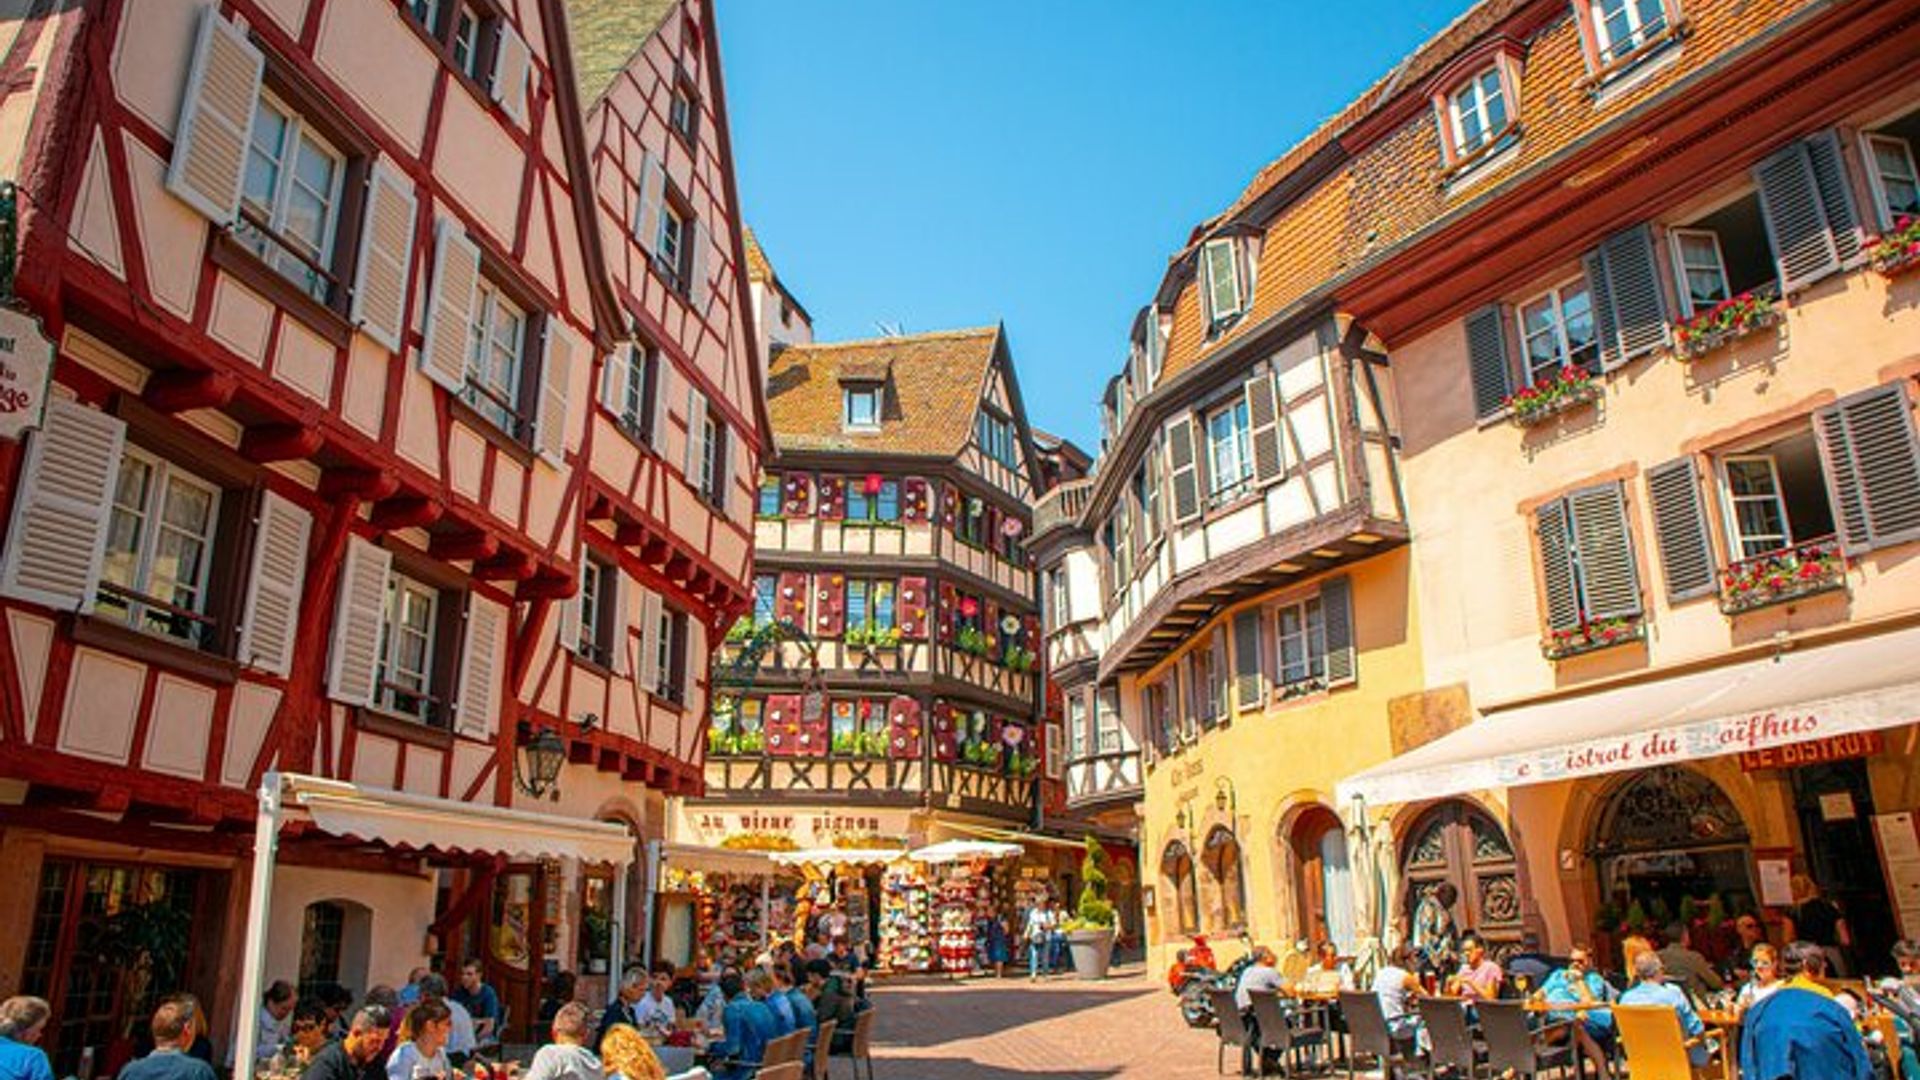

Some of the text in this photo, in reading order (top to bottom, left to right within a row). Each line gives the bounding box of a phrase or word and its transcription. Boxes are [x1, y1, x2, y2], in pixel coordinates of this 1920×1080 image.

[1642, 733, 1679, 757] du
[1743, 750, 1773, 768] LE
[812, 811, 879, 834] pignon
